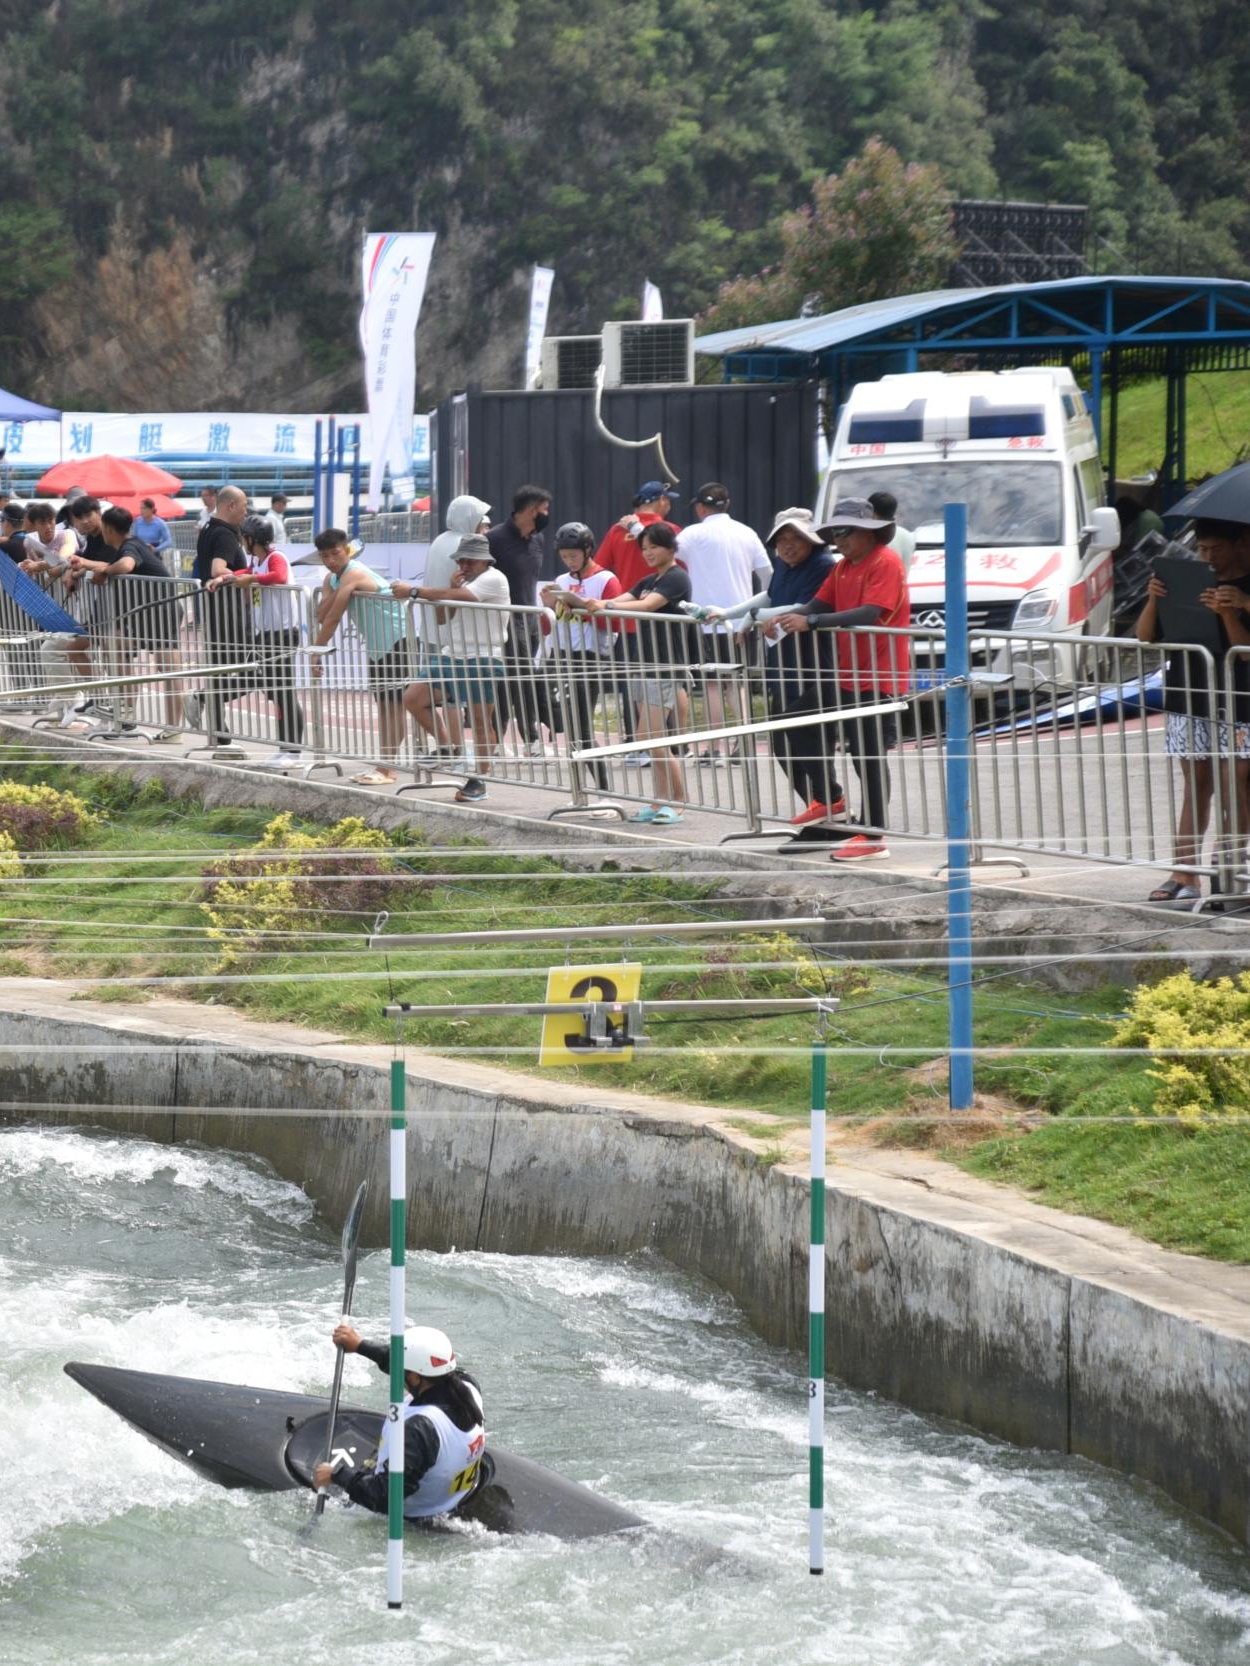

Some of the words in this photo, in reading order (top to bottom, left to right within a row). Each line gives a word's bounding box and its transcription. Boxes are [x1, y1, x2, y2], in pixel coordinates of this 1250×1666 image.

[850, 443, 886, 456] 中国
[564, 975, 618, 1055] 3
[389, 1404, 399, 1422] 3
